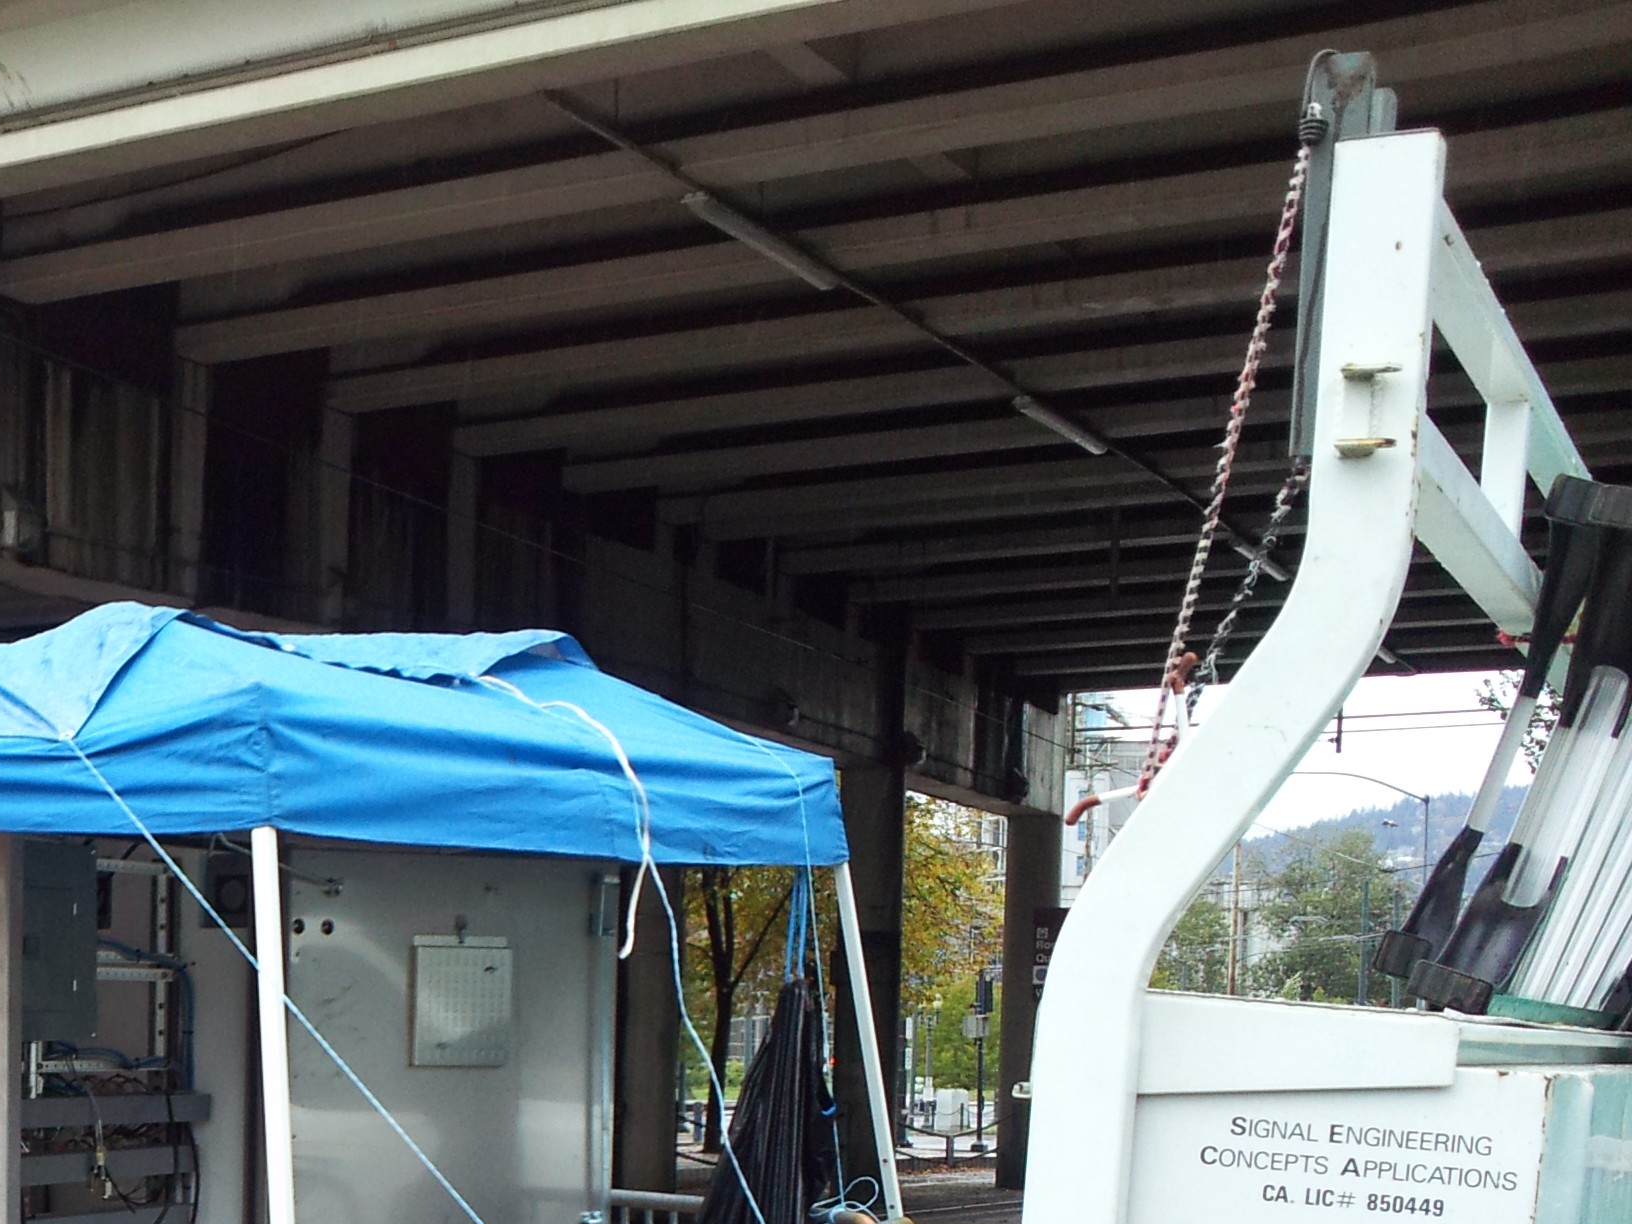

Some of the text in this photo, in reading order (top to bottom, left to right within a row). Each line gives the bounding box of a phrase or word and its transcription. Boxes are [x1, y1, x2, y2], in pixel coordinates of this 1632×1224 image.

[1230, 1116, 1492, 1156] SIGNAL ENGINEERING
[1200, 1146, 1518, 1191] CONCEPTS APPLICATIONS
[1262, 1184, 1295, 1203] CA.
[1367, 1193, 1444, 1217] 850449
